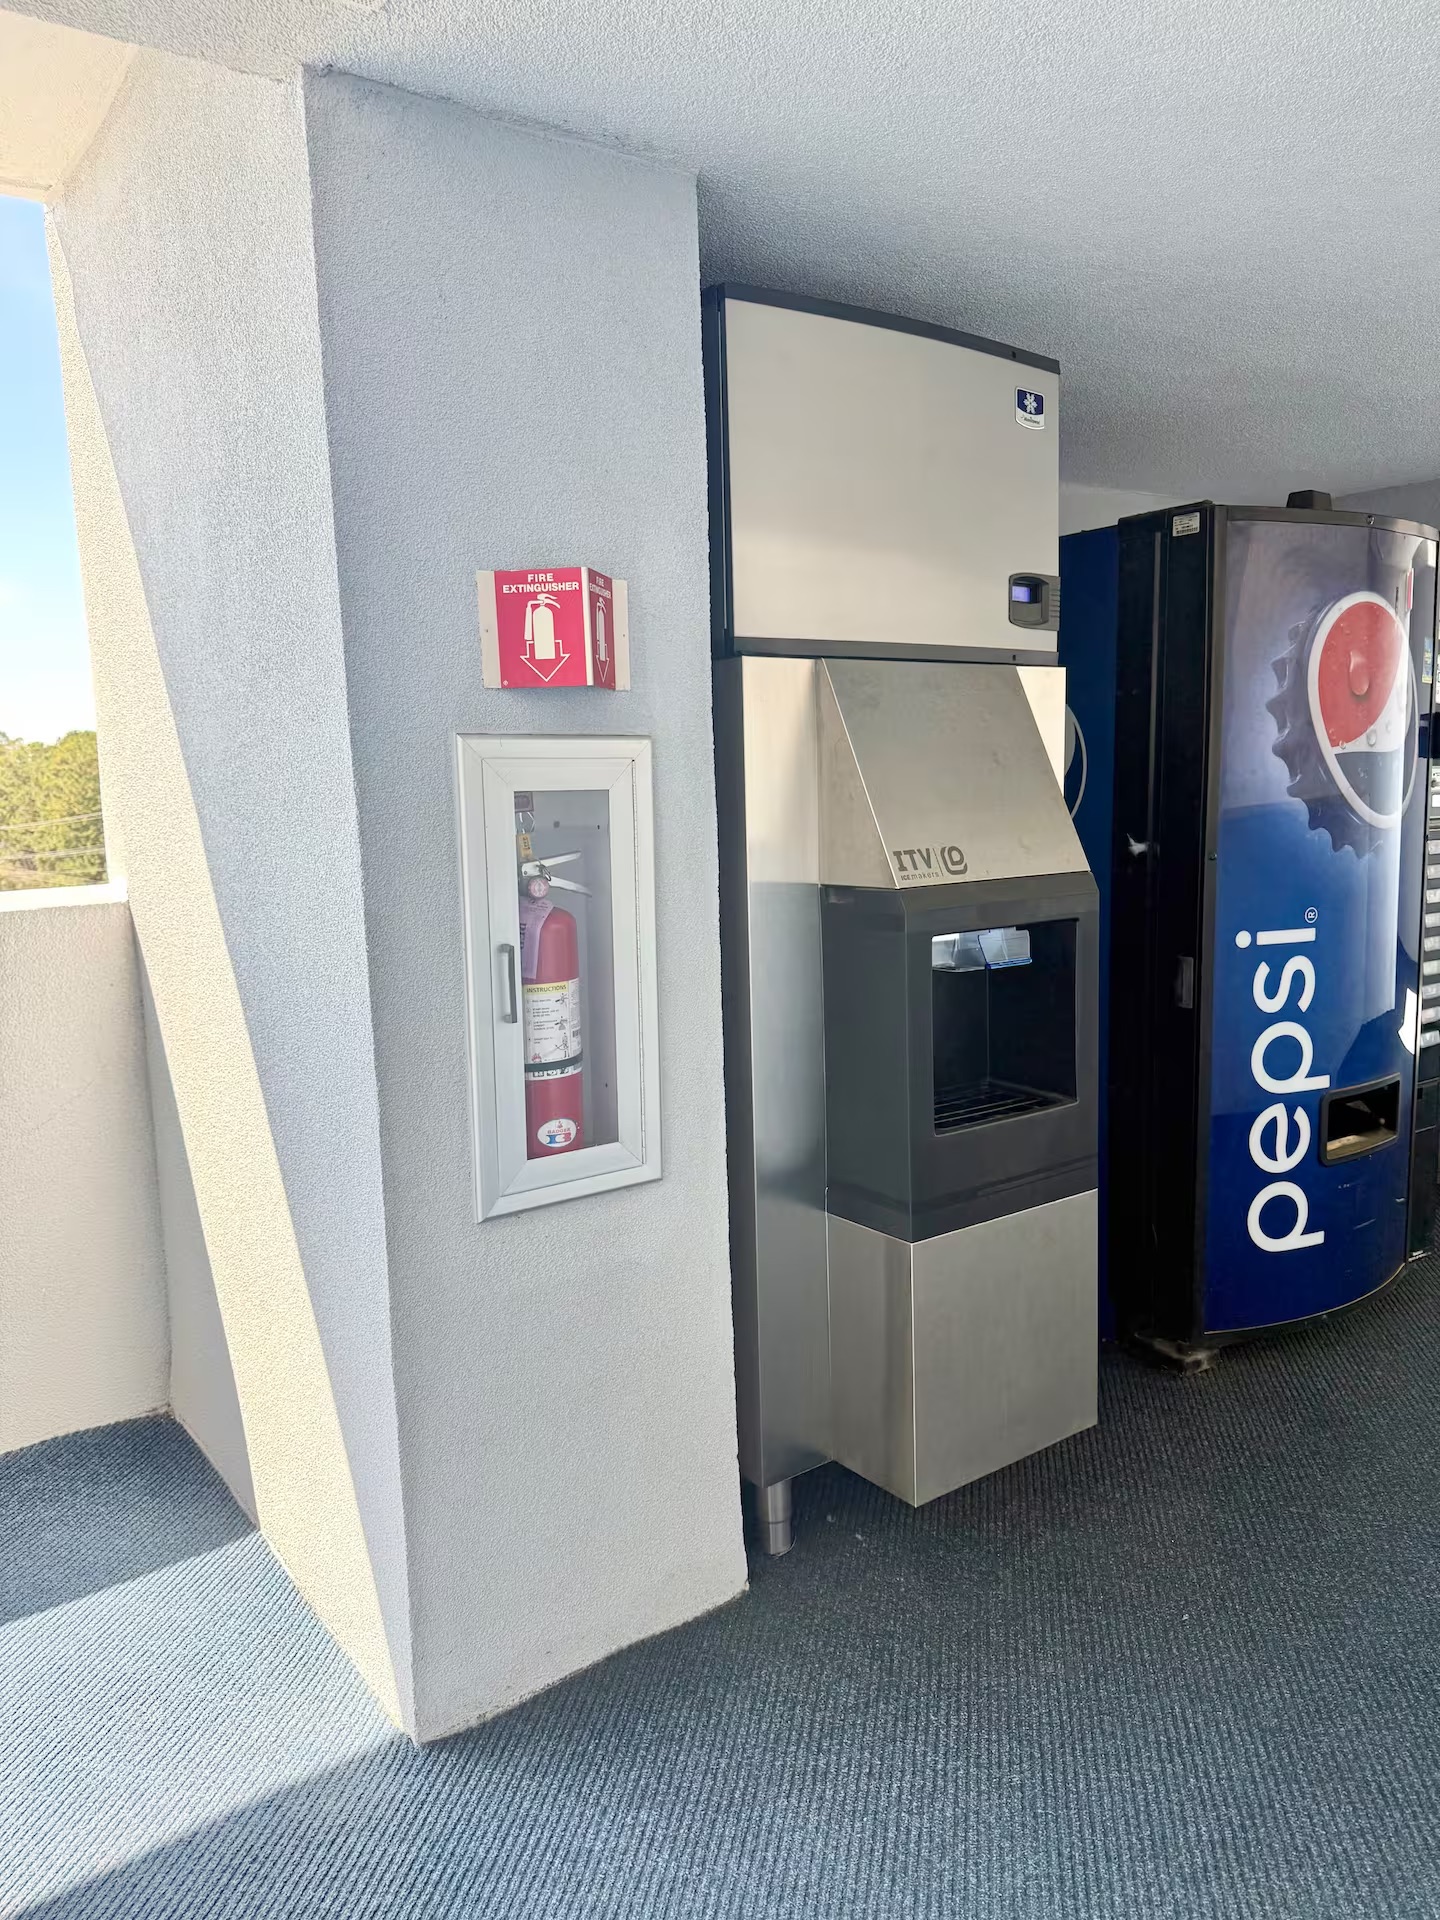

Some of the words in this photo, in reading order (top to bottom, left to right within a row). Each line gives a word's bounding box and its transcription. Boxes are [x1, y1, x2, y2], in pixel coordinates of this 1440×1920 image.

[527, 573, 554, 582] FIRE
[595, 576, 605, 587] FIRE
[502, 581, 580, 594] EXTINGUISHER
[892, 848, 932, 872] ITV
[526, 984, 567, 993] INSTRUCTIONS
[1235, 927, 1331, 1253] pepsi
[547, 1127, 571, 1135] BADGER
